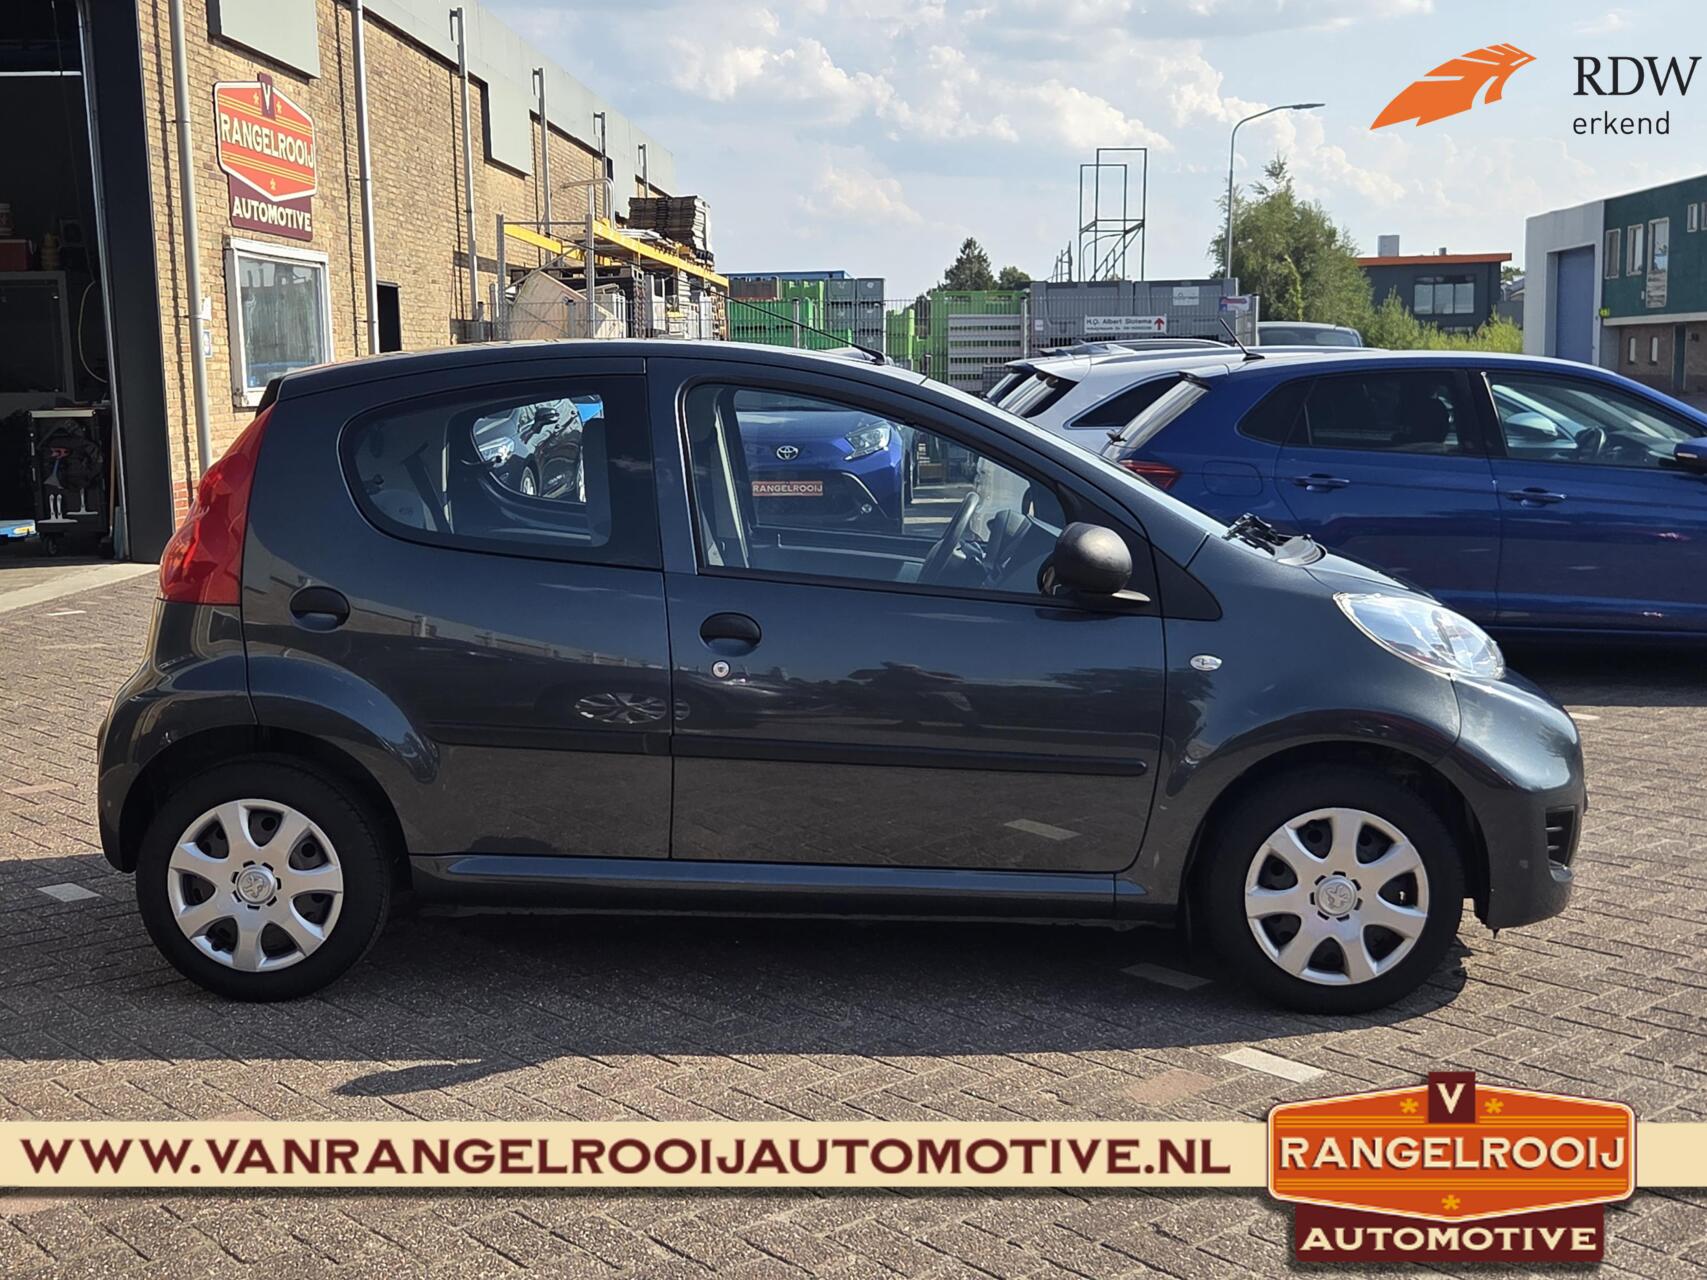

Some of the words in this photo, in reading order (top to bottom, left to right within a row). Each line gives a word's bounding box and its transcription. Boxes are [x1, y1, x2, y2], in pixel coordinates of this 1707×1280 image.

[261, 83, 272, 111] V
[220, 112, 314, 169] RANGELROOIJ
[232, 196, 312, 232] AUTOMOTIVE
[752, 483, 823, 493] RANGELROOIJ
